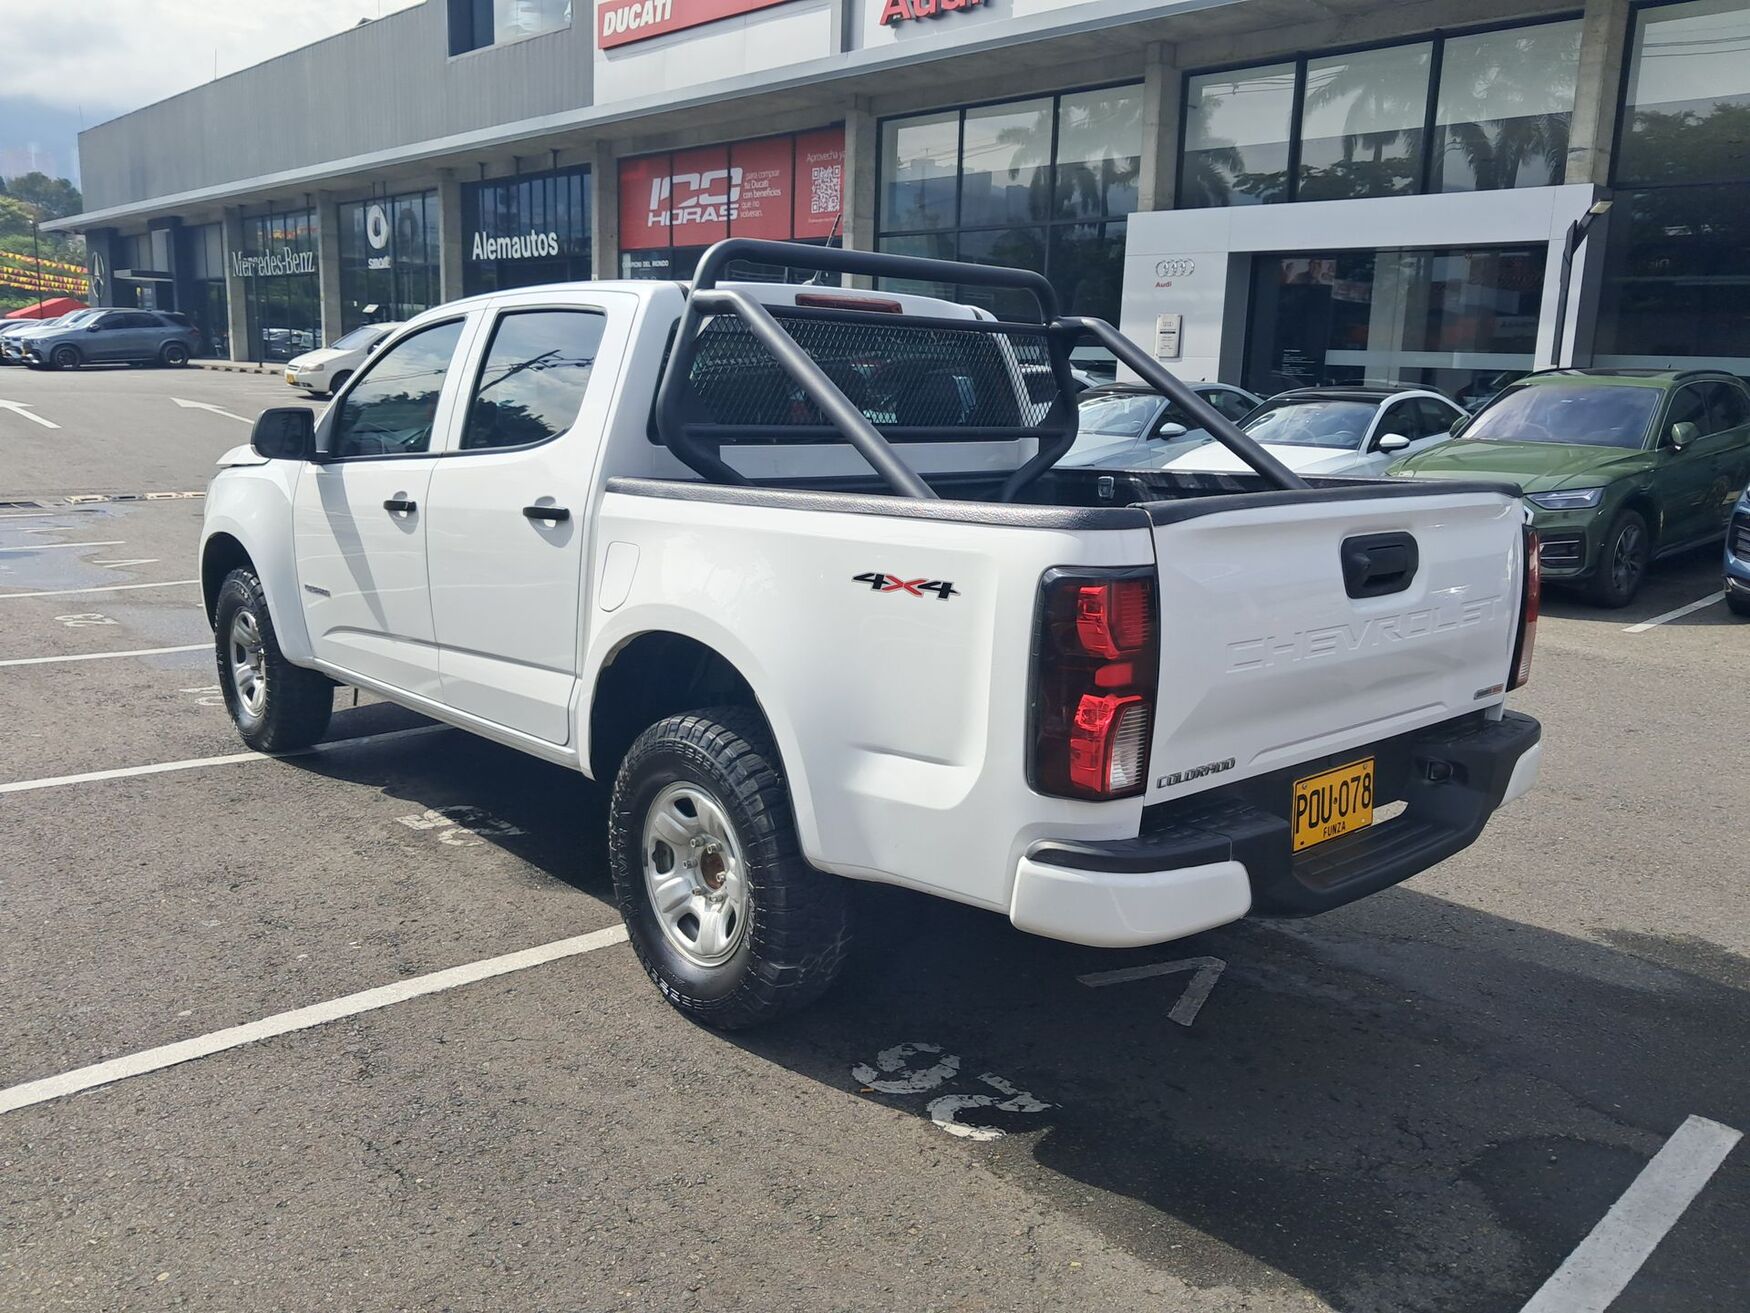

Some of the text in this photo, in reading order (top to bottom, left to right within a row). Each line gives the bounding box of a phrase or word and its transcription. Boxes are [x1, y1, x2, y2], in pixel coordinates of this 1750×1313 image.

[602, 0, 673, 37] DUCATI
[647, 203, 740, 227] HORAS
[472, 229, 559, 260] Alemautos
[1155, 280, 1173, 289] Audi
[1225, 597, 1503, 674] CHEVROLET
[1156, 757, 1236, 789] COLORADO
[1323, 821, 1346, 838] FUNZA
